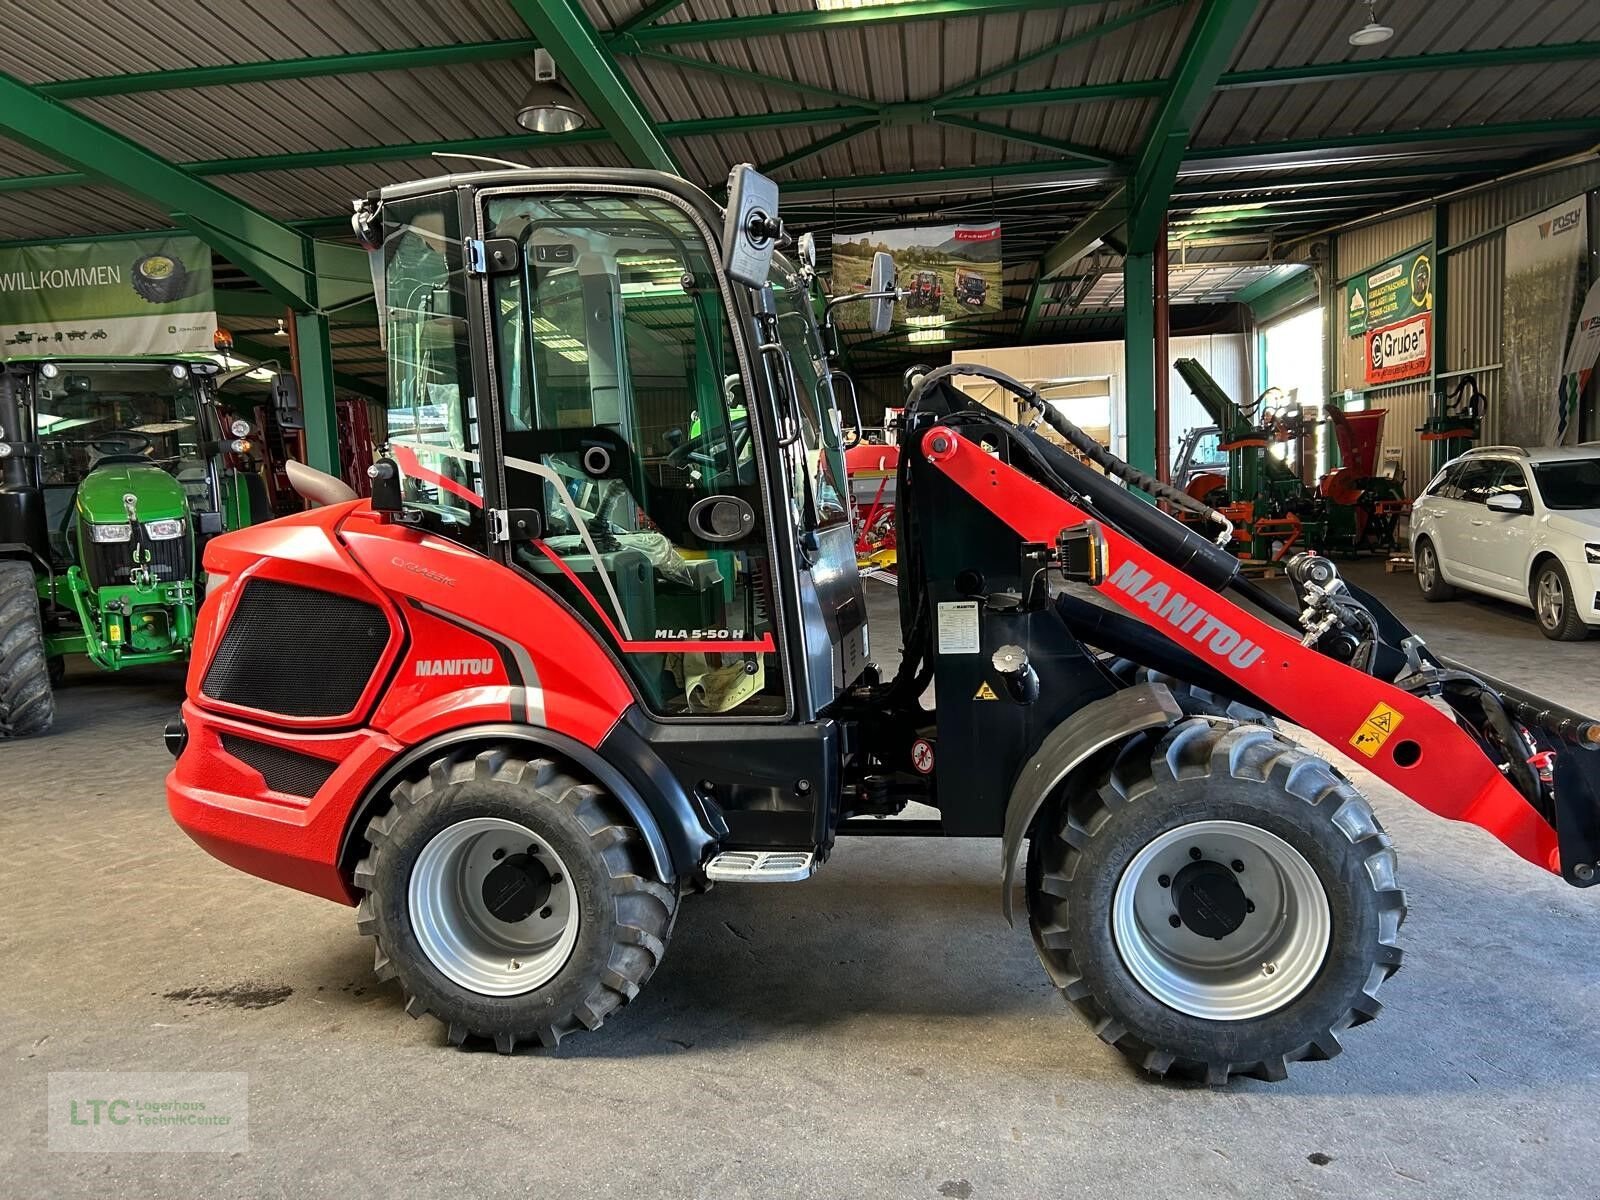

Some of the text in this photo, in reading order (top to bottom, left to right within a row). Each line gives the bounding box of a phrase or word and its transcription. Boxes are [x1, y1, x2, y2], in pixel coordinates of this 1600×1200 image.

[1552, 207, 1581, 232] POSCH
[0, 264, 121, 293] WILLKOMMEN
[1384, 328, 1425, 357] Gruber
[1107, 560, 1266, 670] MANITOU
[654, 629, 744, 640] MLA 5-50 H
[415, 658, 494, 677] MANITOU
